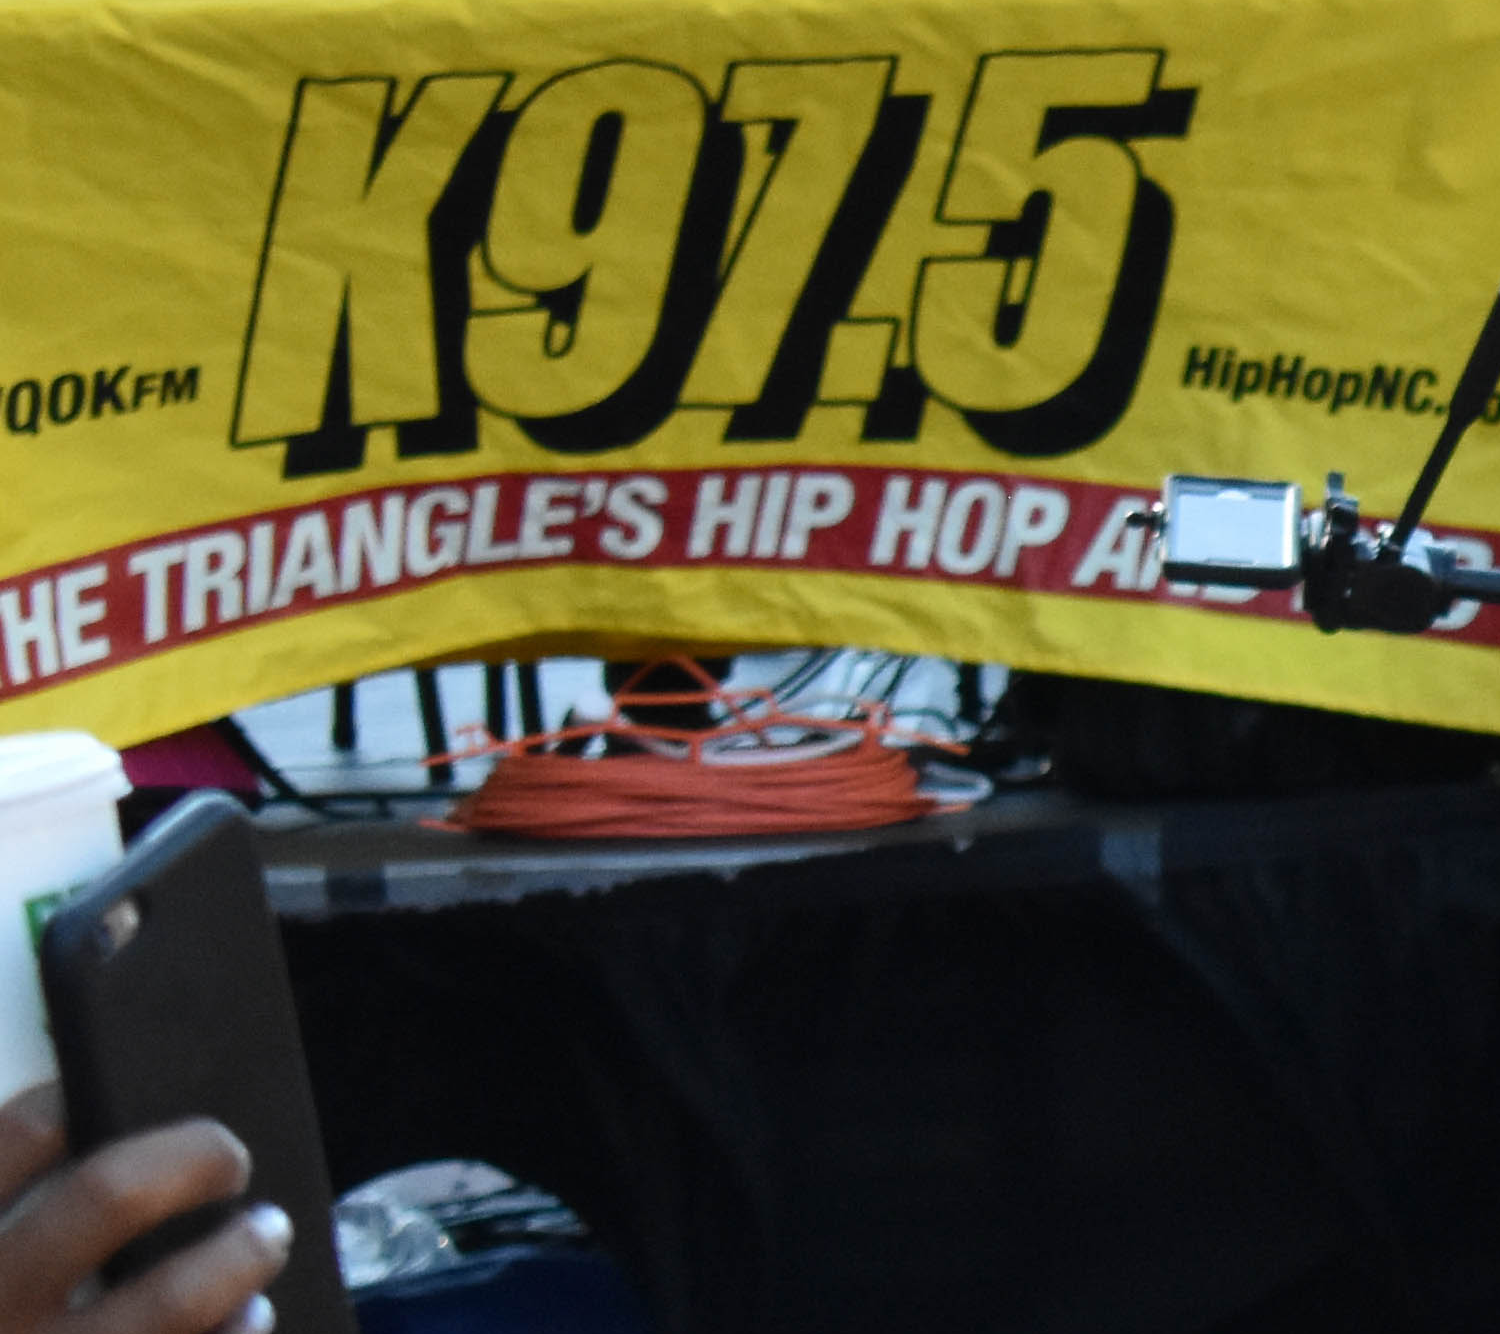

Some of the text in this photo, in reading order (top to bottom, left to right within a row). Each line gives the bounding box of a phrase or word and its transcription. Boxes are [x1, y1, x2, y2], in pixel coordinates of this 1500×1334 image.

[230, 49, 1200, 479] K97.5
[0, 364, 201, 438] QOKFM
[0, 562, 110, 688] HE
[130, 475, 669, 644] TRIANGLE'S
[688, 474, 854, 561] HIP
[870, 473, 1069, 577] HOP
